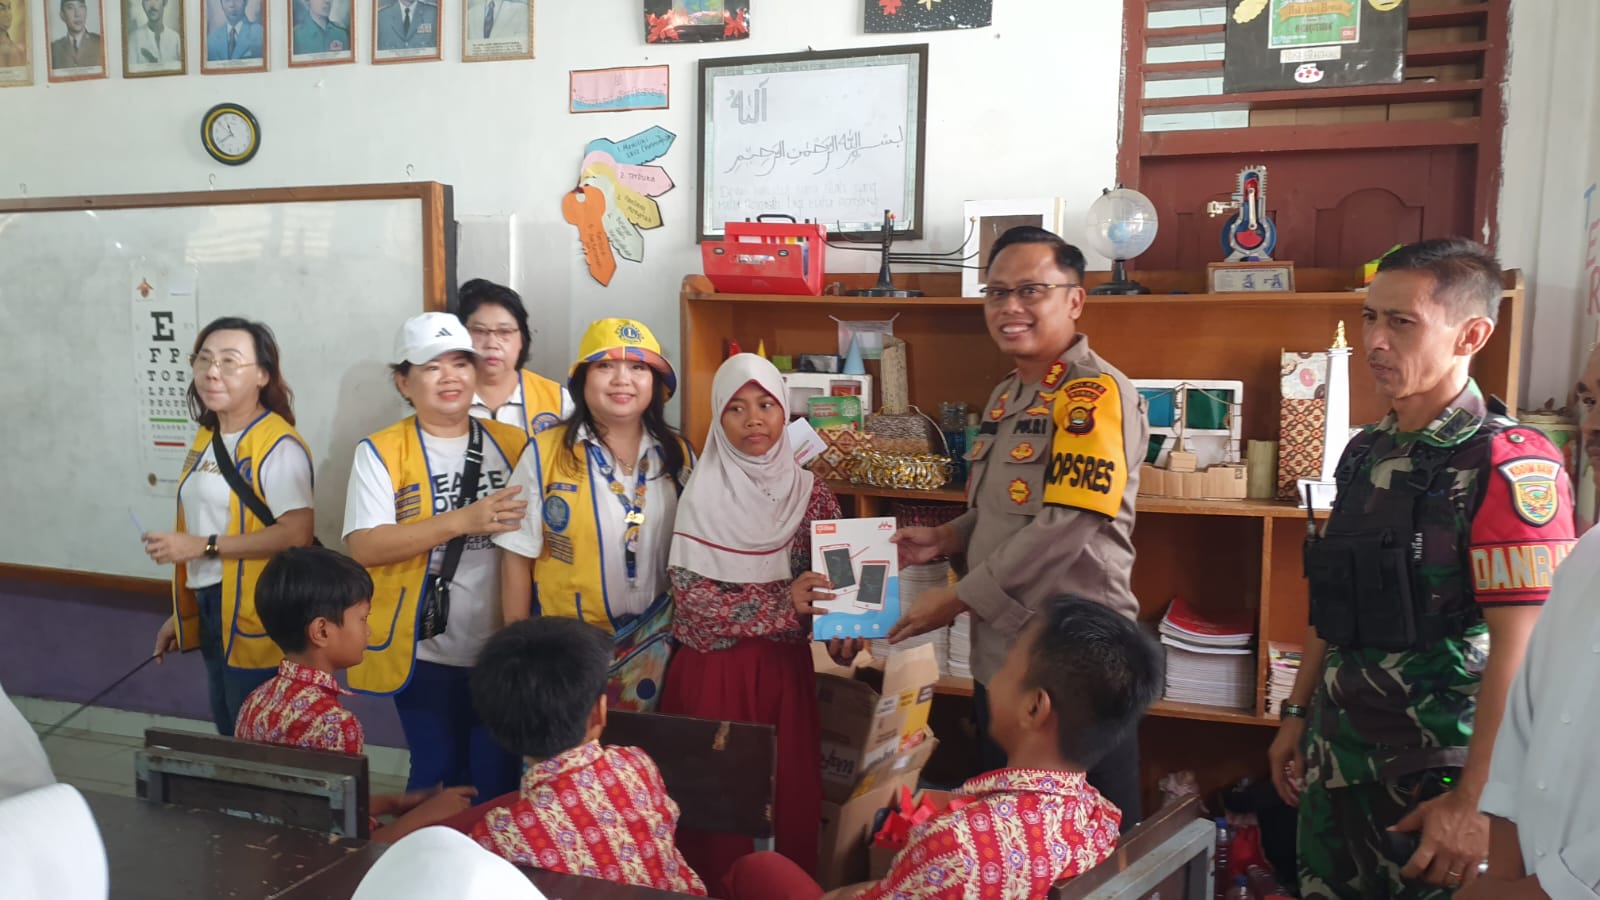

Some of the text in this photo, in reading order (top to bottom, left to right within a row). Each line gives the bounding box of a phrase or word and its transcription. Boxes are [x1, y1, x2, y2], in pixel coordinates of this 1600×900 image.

[151, 311, 175, 342] E
[149, 347, 180, 363] F P
[1046, 452, 1115, 494] OPSRES
